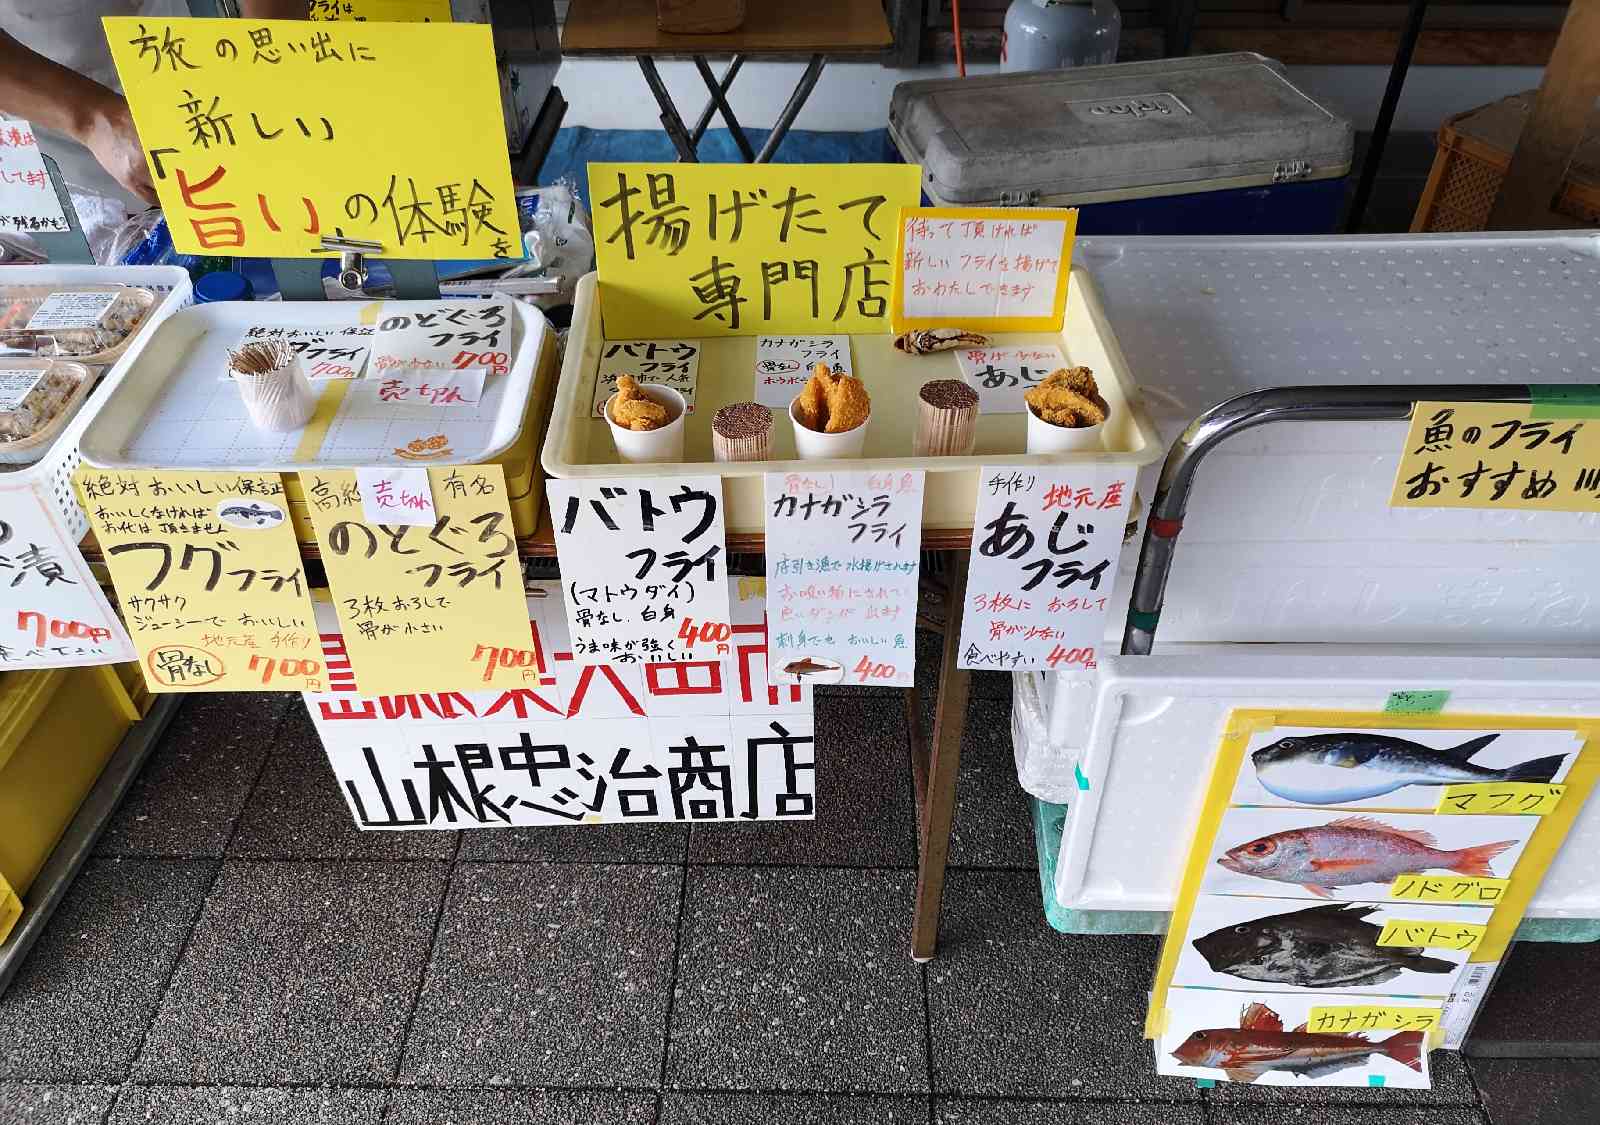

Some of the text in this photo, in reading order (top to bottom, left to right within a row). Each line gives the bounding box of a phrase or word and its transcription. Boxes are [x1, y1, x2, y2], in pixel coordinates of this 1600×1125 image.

[131, 25, 376, 72] 旅の思い出に
[178, 90, 334, 148] 新しい
[600, 172, 889, 260] 揚げたて
[689, 247, 892, 329] 専門店
[378, 305, 506, 331] のどぐろ
[428, 329, 502, 348] フライ
[604, 343, 697, 361] バトウ
[639, 361, 690, 374] フライ
[1413, 408, 1584, 455] 魚のフライ
[442, 469, 496, 499] 有名
[989, 472, 1126, 511] 手作り 地元産
[560, 485, 718, 544] バトウ
[773, 493, 891, 520] カナガシラ
[848, 521, 907, 548] フライ
[979, 501, 1094, 560] あじ
[624, 544, 721, 583] フライ
[1021, 559, 1110, 592] フライ
[128, 595, 188, 612] サクサク
[345, 721, 814, 828] 山根忠治商店
[1447, 788, 1561, 811] マフグ
[1394, 880, 1502, 900] ノドグロ
[1383, 927, 1478, 950] バトウ
[1317, 1010, 1434, 1030] カナガシラ
